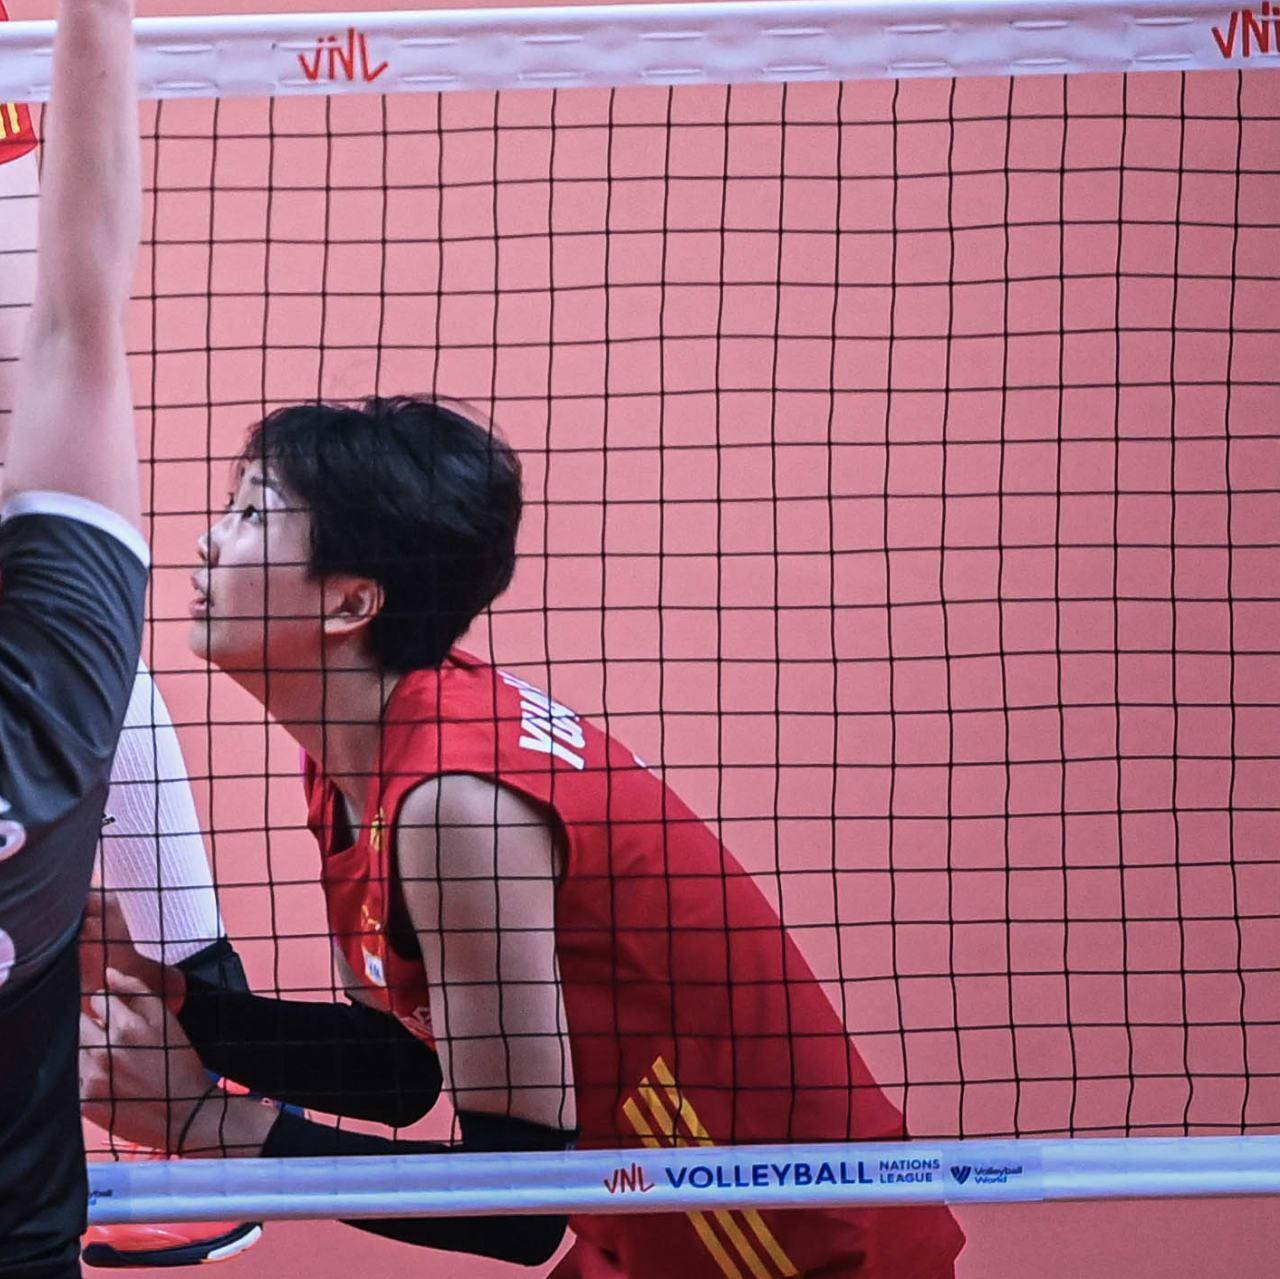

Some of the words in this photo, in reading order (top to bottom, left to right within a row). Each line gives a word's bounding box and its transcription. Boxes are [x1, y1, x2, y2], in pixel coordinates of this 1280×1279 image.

[1210, 0, 1280, 59] VN
[298, 26, 389, 83] VNL
[603, 1161, 656, 1195] VNL
[665, 1160, 874, 1190] VOLLEYBALL
[878, 1158, 940, 1171] NATIONS
[878, 1172, 933, 1184] LEAGUE
